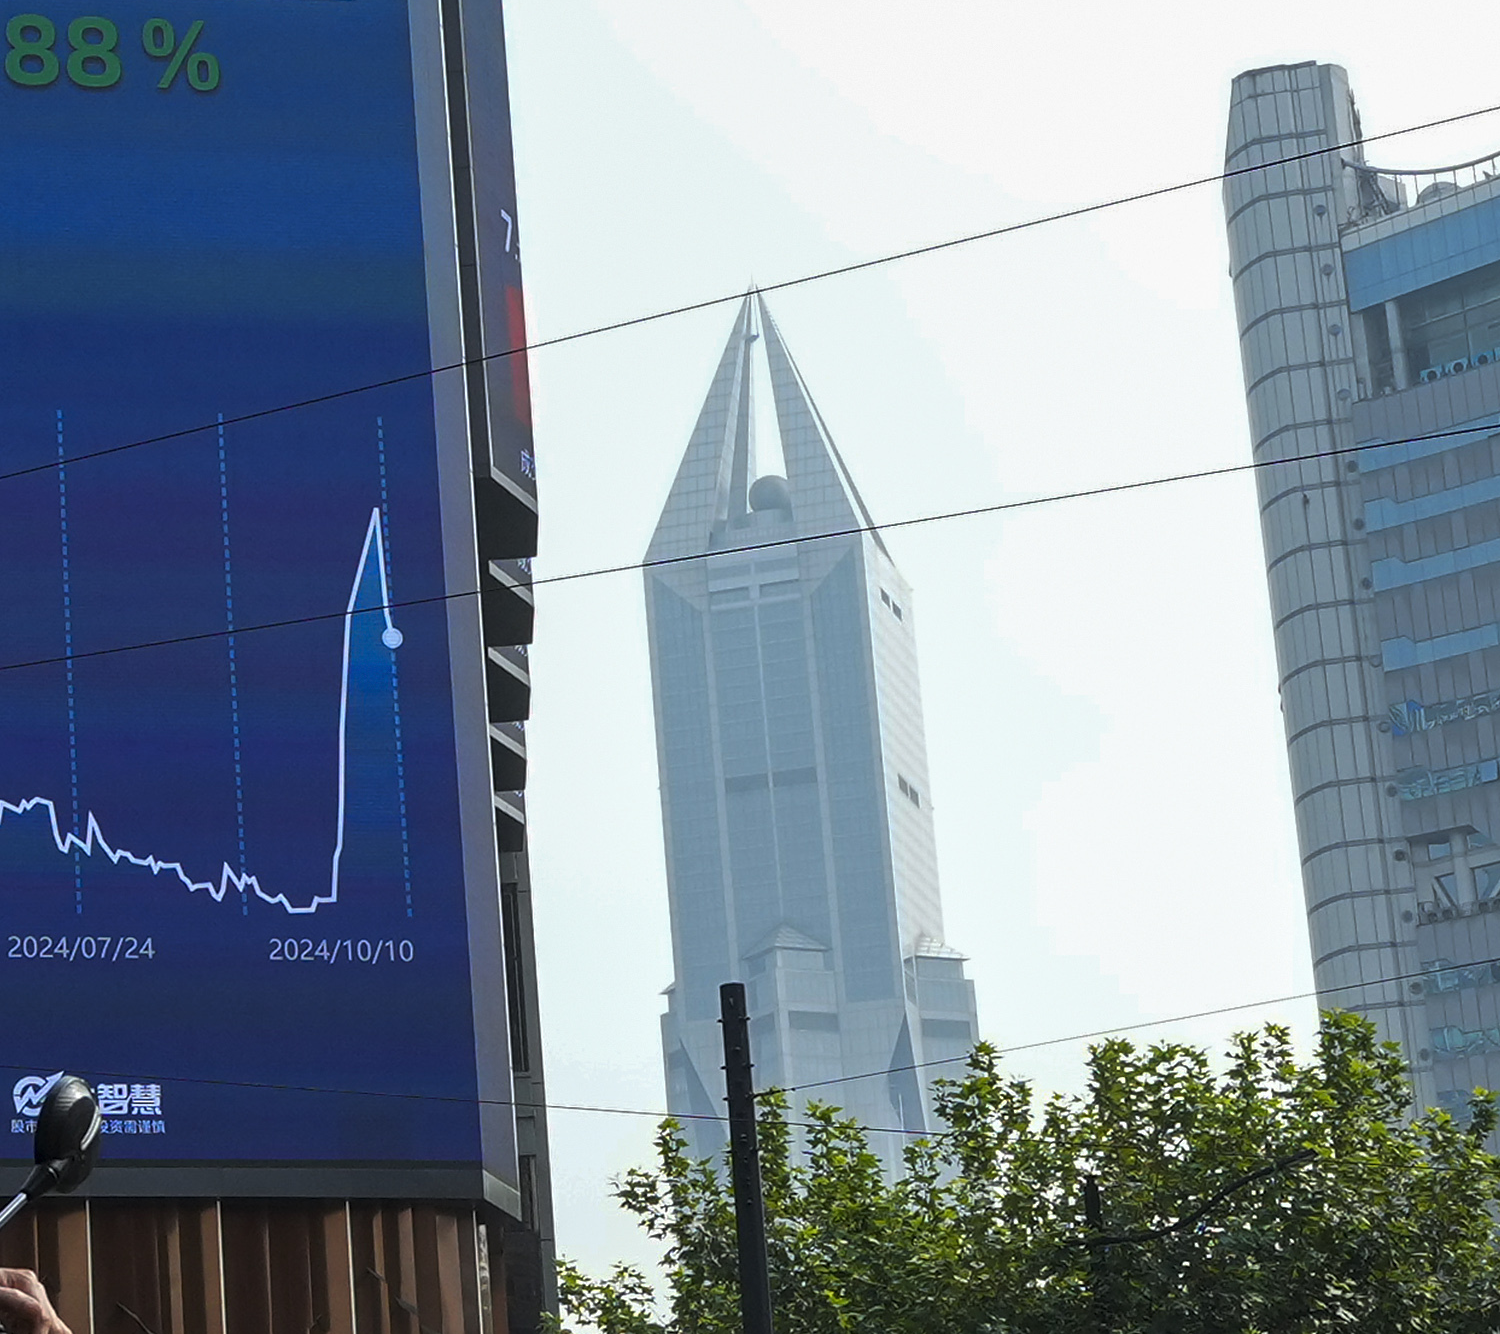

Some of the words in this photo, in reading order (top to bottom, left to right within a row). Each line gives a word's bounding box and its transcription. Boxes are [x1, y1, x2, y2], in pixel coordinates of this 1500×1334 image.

[7, 934, 156, 963] 2024/07/24
[268, 937, 415, 966] 2024/10/10
[92, 1083, 163, 1117] 智慧
